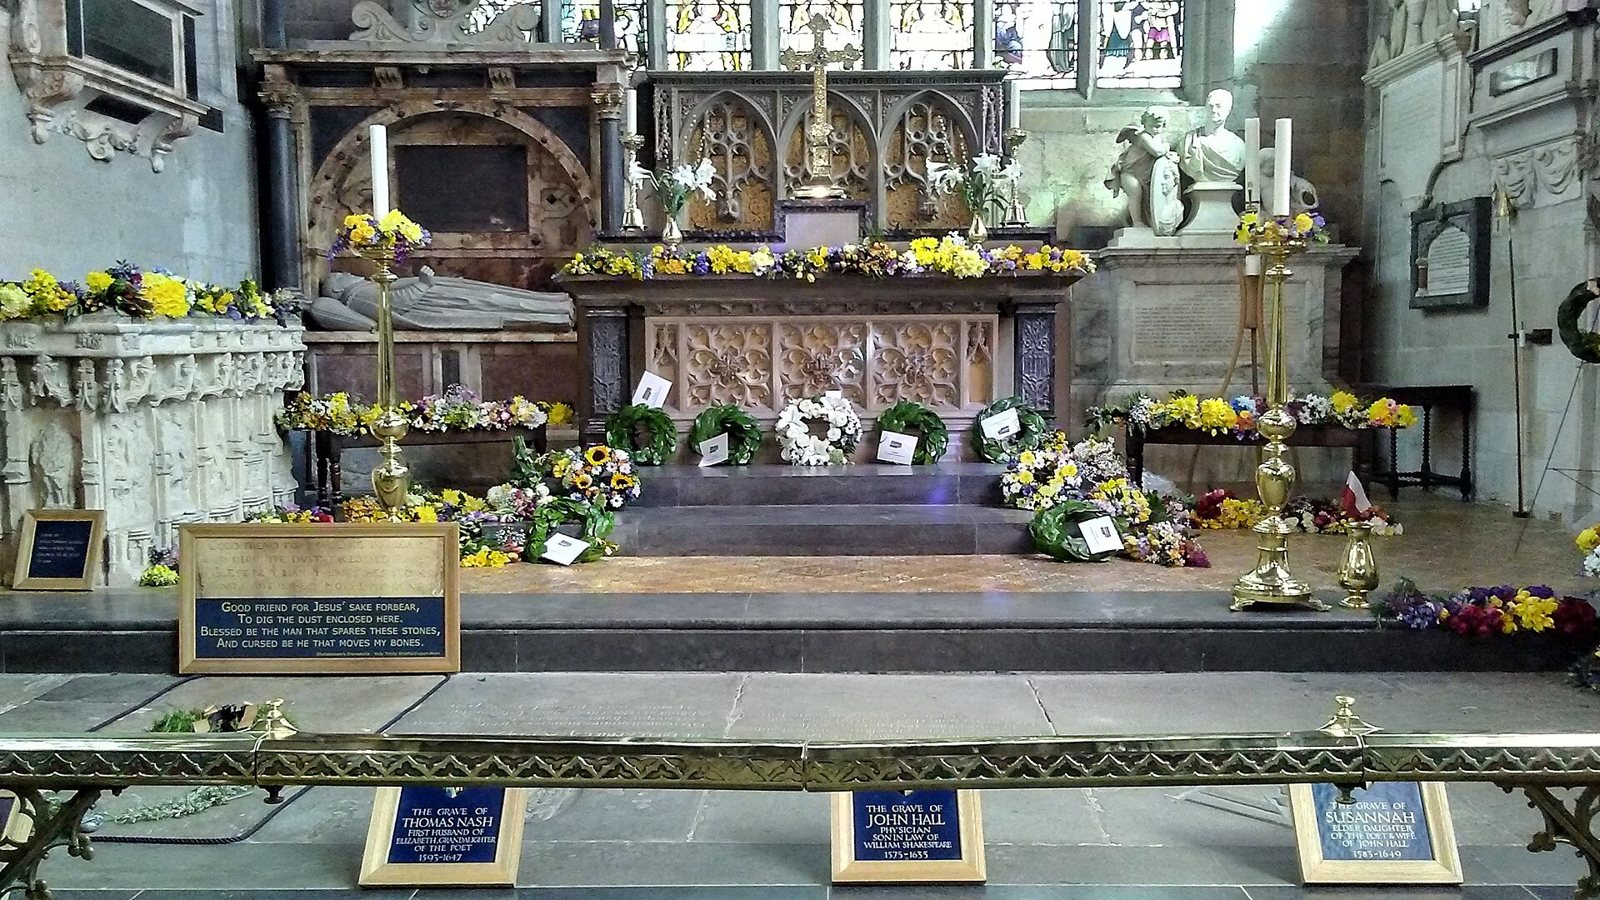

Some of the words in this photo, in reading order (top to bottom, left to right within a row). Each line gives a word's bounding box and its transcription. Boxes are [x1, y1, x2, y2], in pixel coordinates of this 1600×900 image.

[222, 602, 251, 612] GOOD
[255, 603, 287, 612] FRIEND
[291, 603, 309, 612] FOR
[349, 603, 372, 612] SAKE
[376, 603, 419, 613] FORBEAR,
[238, 613, 252, 624] TO
[256, 615, 273, 624] DIG
[277, 615, 295, 624] THE
[298, 615, 322, 624] DUST
[326, 615, 372, 624] ENCLOSED
[376, 615, 403, 624] HERE.
[201, 626, 242, 636] BLESSED
[246, 627, 258, 636] BE
[261, 627, 279, 636] THE
[283, 627, 302, 636] MAN
[306, 627, 329, 636] THAT
[332, 627, 365, 636] SPARES
[370, 627, 398, 636] THESE
[402, 627, 441, 637] STONES,
[217, 638, 238, 648] AND
[242, 639, 278, 648] CURSED
[282, 639, 293, 648] BE
[297, 639, 309, 648] HE
[313, 639, 336, 648] THAT
[339, 639, 370, 648] MOVES
[374, 639, 386, 648] MY
[390, 639, 424, 648] BONES.
[866, 805, 886, 813] THE
[892, 805, 923, 813] GRAVE
[1330, 801, 1351, 810] THE
[1356, 802, 1387, 810] GRAVE
[1393, 802, 1406, 810] OF
[437, 808, 467, 816] GRAVE
[866, 814, 907, 828] JOHN
[912, 814, 945, 825] HALL
[1325, 812, 1416, 823] SUSANNAH
[402, 817, 454, 828] THOMAS
[457, 817, 493, 827] NASH
[1364, 825, 1413, 833] DAUGHTER
[1358, 840, 1383, 848] JOHN
[884, 851, 928, 859] 1575-1635
[1353, 850, 1401, 858] 1583-1649
